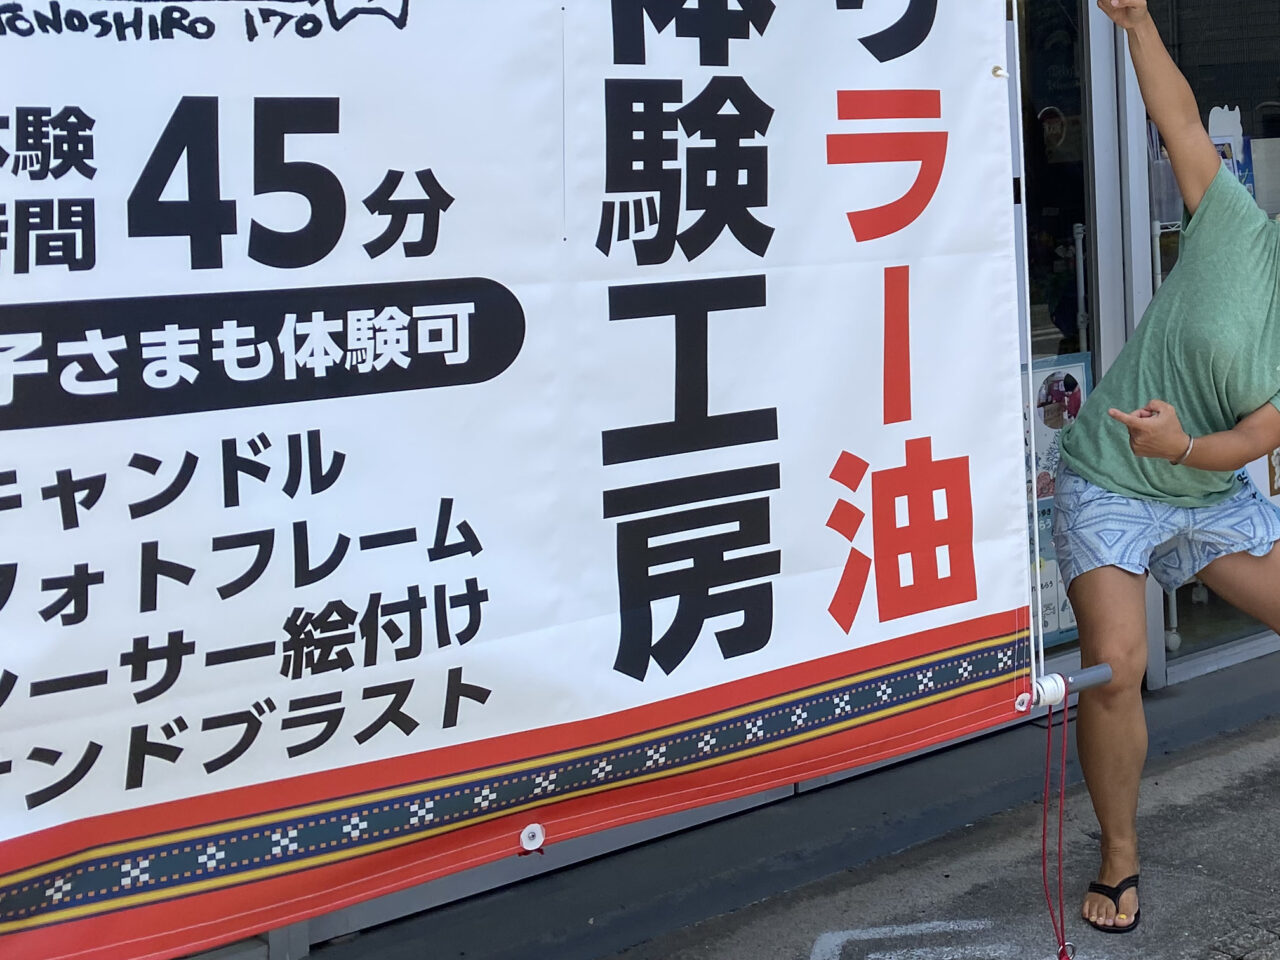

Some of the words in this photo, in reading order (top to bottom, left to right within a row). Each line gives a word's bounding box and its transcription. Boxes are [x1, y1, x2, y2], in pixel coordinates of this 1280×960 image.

[244, 8, 324, 42] 170
[0, 197, 97, 275] 間
[0, 497, 484, 627] ォトフレーム
[0, 577, 489, 708] ーサー絵付け
[0, 667, 492, 811] ンドブラスト
